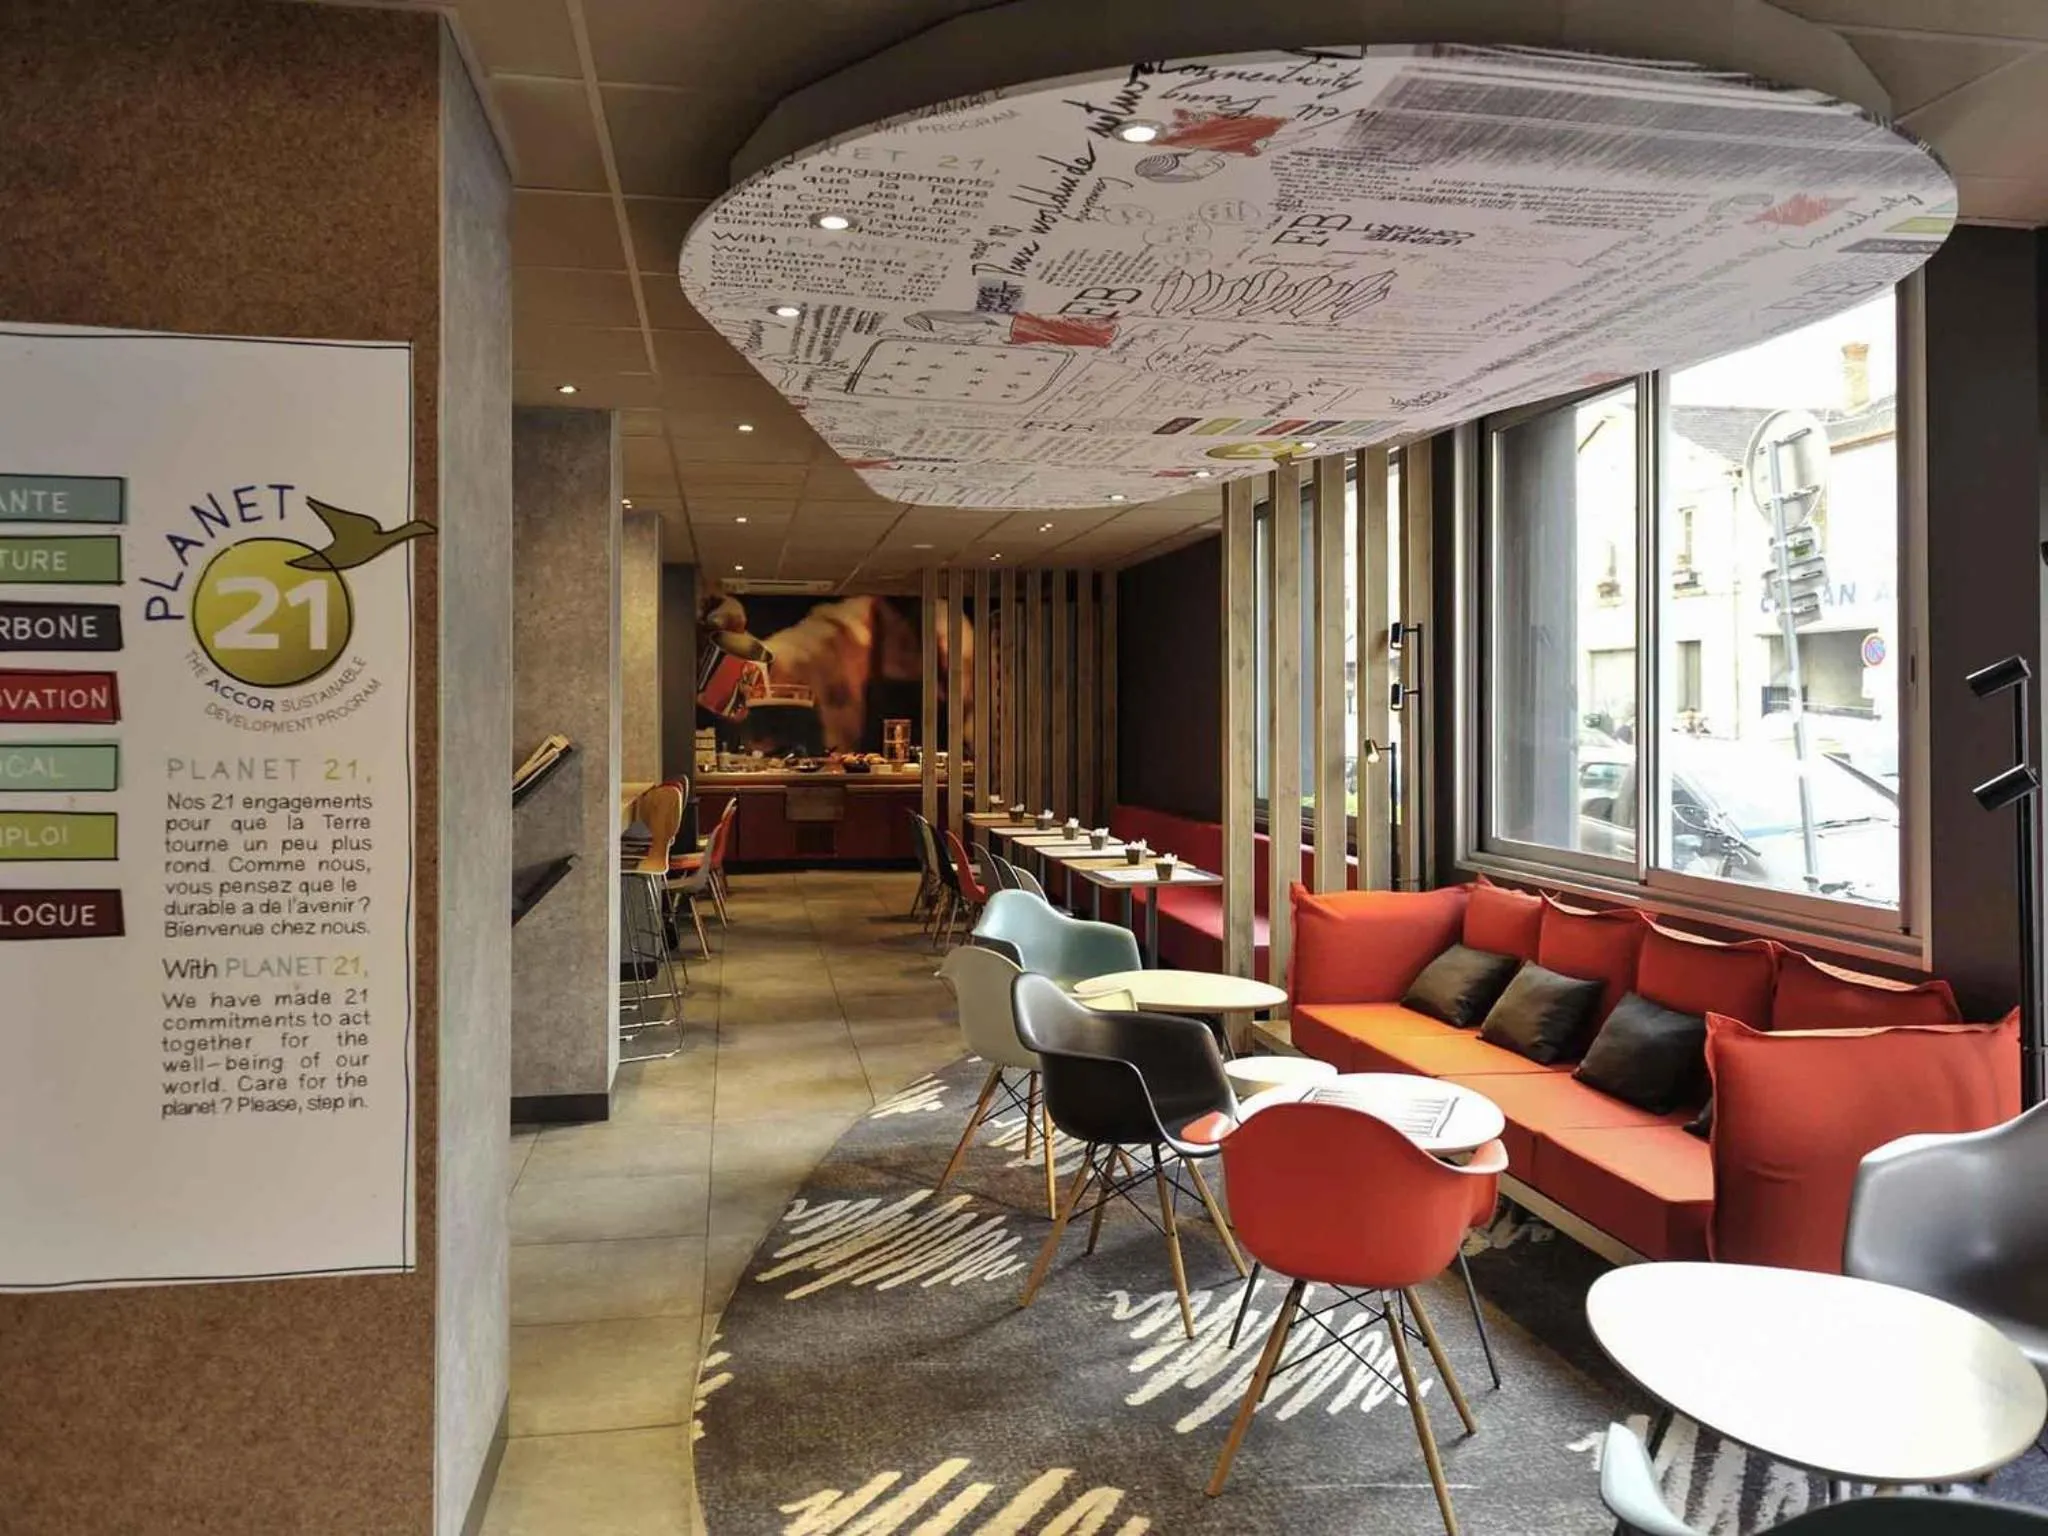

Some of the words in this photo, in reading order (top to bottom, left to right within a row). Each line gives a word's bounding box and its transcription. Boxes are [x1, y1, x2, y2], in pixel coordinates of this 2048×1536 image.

[711, 230, 776, 245] With
[0, 549, 67, 572] TURE
[140, 484, 295, 622] PLANET
[213, 576, 329, 650] 21
[184, 648, 209, 678] THE
[205, 678, 275, 712] ACCOR
[280, 655, 367, 713] SUSTAINABLE
[0, 687, 107, 709] VATION
[204, 702, 314, 734] DEVELOPMENT
[316, 677, 381, 726] PROGRAM
[0, 754, 64, 778] CAL
[167, 758, 301, 782] PLANET
[324, 758, 371, 783] 21,
[167, 793, 205, 811] Nos
[211, 793, 234, 810] 21
[242, 793, 373, 814] engagements
[0, 826, 68, 846] PLOI
[165, 817, 211, 835] pour
[231, 817, 267, 836] que
[287, 814, 304, 831] la
[323, 814, 371, 831] Terre
[164, 837, 229, 854] tourne
[243, 838, 268, 852] un
[281, 838, 317, 855] peu
[331, 836, 372, 854] plus
[228, 855, 305, 873] Comme
[318, 857, 371, 875] nous,
[165, 881, 212, 895] vous
[219, 879, 291, 898] pensez
[298, 879, 334, 897] que
[341, 877, 357, 893] le
[0, 903, 96, 926] LOGUE
[164, 899, 236, 916] durable
[241, 902, 254, 916] a
[258, 898, 282, 915] de
[287, 897, 355, 915] l'avenir
[164, 920, 265, 938] Bienvenue
[270, 919, 315, 936] chez
[320, 920, 370, 936] nous.
[162, 957, 218, 980] With
[225, 956, 329, 978] PLANET
[162, 992, 197, 1009] We
[210, 990, 261, 1008] have
[274, 989, 331, 1007] made
[345, 988, 369, 1005] 21
[162, 1012, 306, 1031] commitments
[312, 1011, 332, 1027] to
[338, 1010, 371, 1027] act
[161, 1035, 252, 1056] together
[280, 1032, 309, 1049] for
[337, 1031, 369, 1047] the
[300, 1053, 321, 1069] of
[336, 1054, 370, 1069] our
[162, 1077, 226, 1096] world.
[237, 1075, 287, 1093] Care
[299, 1073, 328, 1091] for
[337, 1072, 369, 1089] the
[162, 1099, 217, 1119] planet
[237, 1097, 303, 1115] Please,
[307, 1095, 345, 1114] step
[347, 1094, 369, 1110] in.
